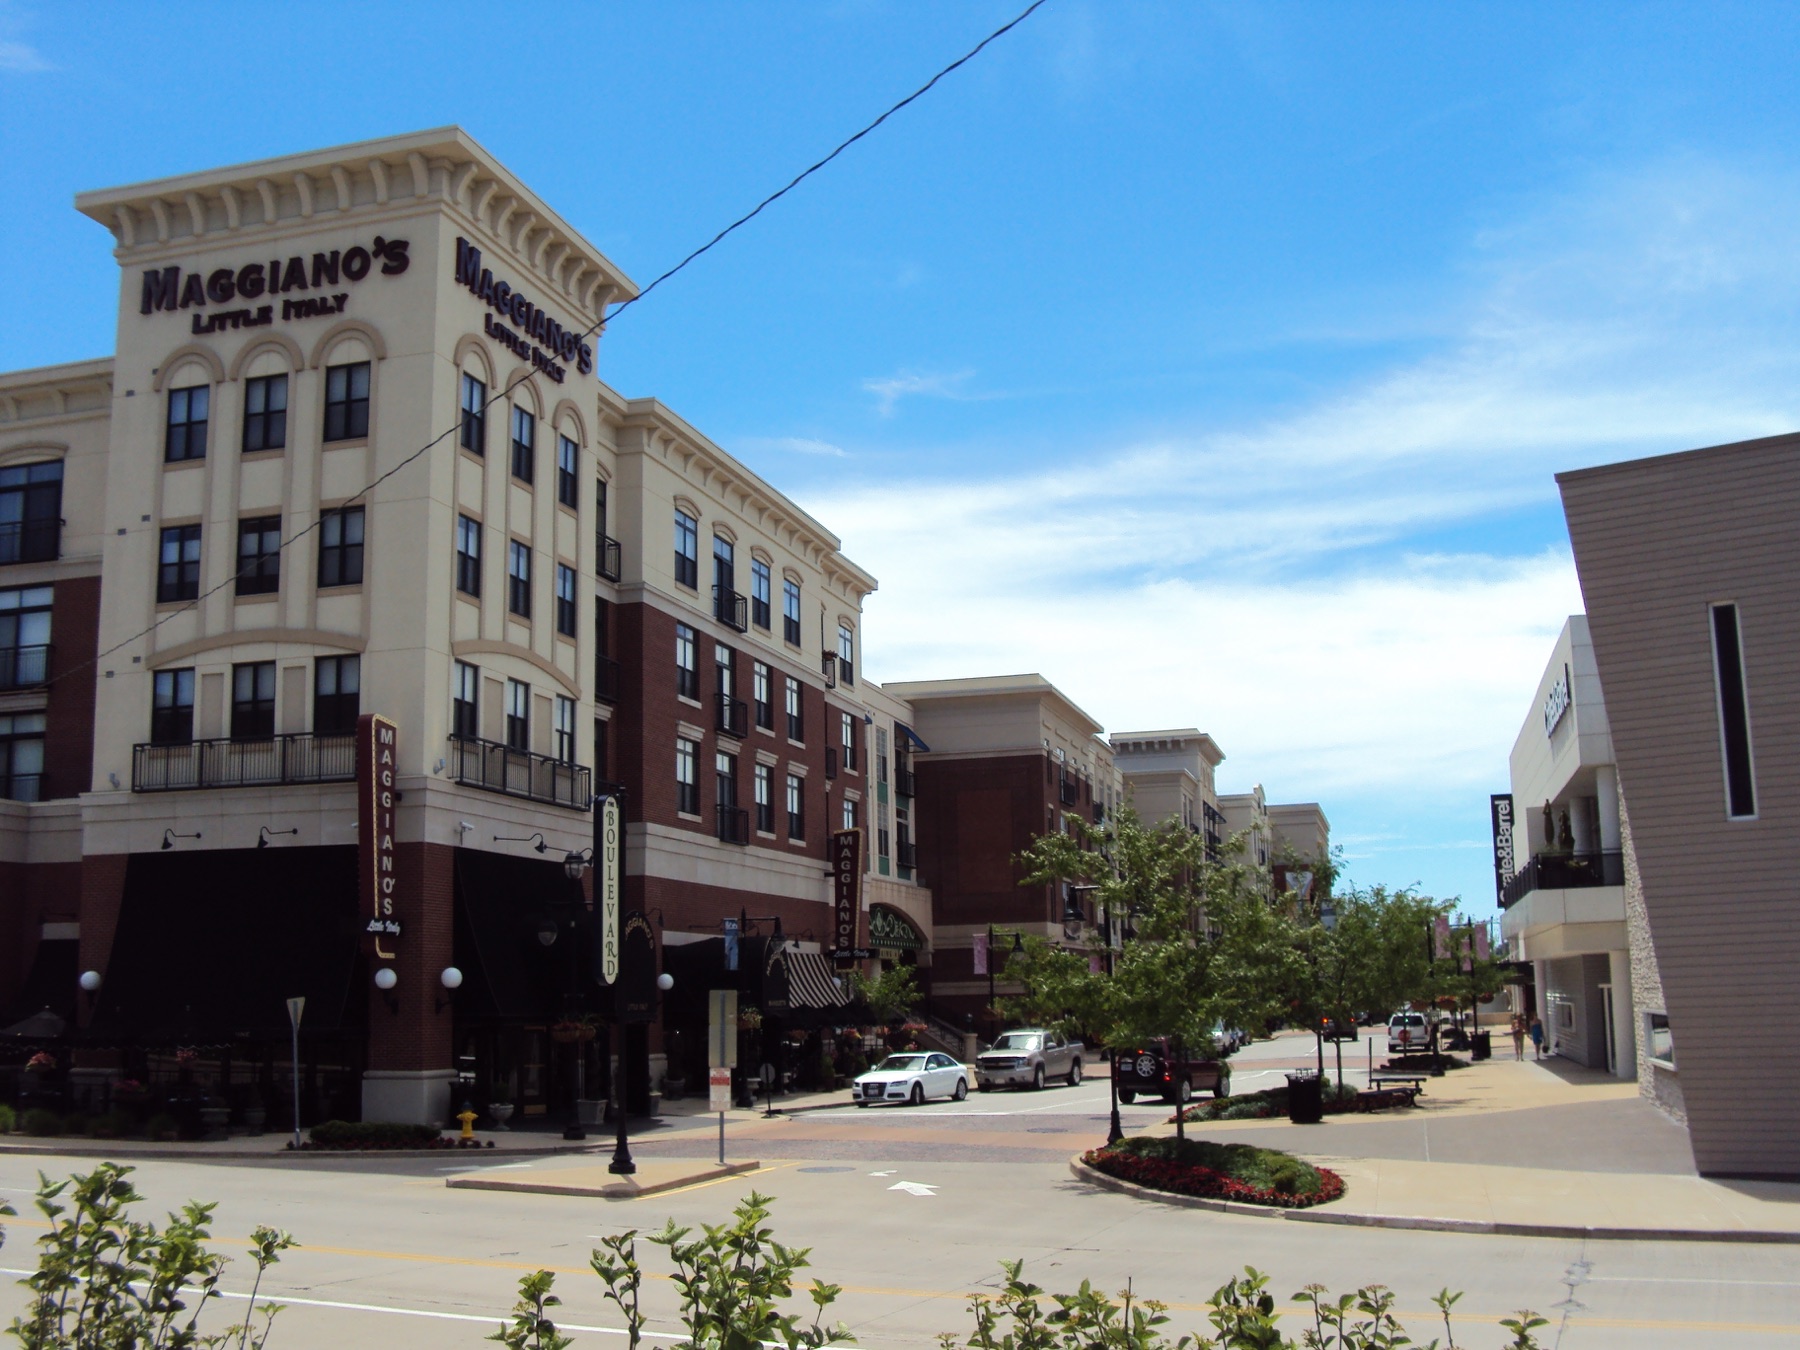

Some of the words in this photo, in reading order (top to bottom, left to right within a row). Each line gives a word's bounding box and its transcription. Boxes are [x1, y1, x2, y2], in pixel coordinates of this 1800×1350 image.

[139, 235, 411, 315] MAGGIANO'S
[192, 305, 273, 335] LITTLE
[282, 293, 349, 321] ITALY
[455, 236, 593, 375] MAGGIANO'S
[484, 312, 531, 362] LITTLE
[380, 727, 396, 916] MAGGIANO'S
[605, 811, 617, 976] BOULEVARD
[839, 836, 853, 947] MAGGIANO'S
